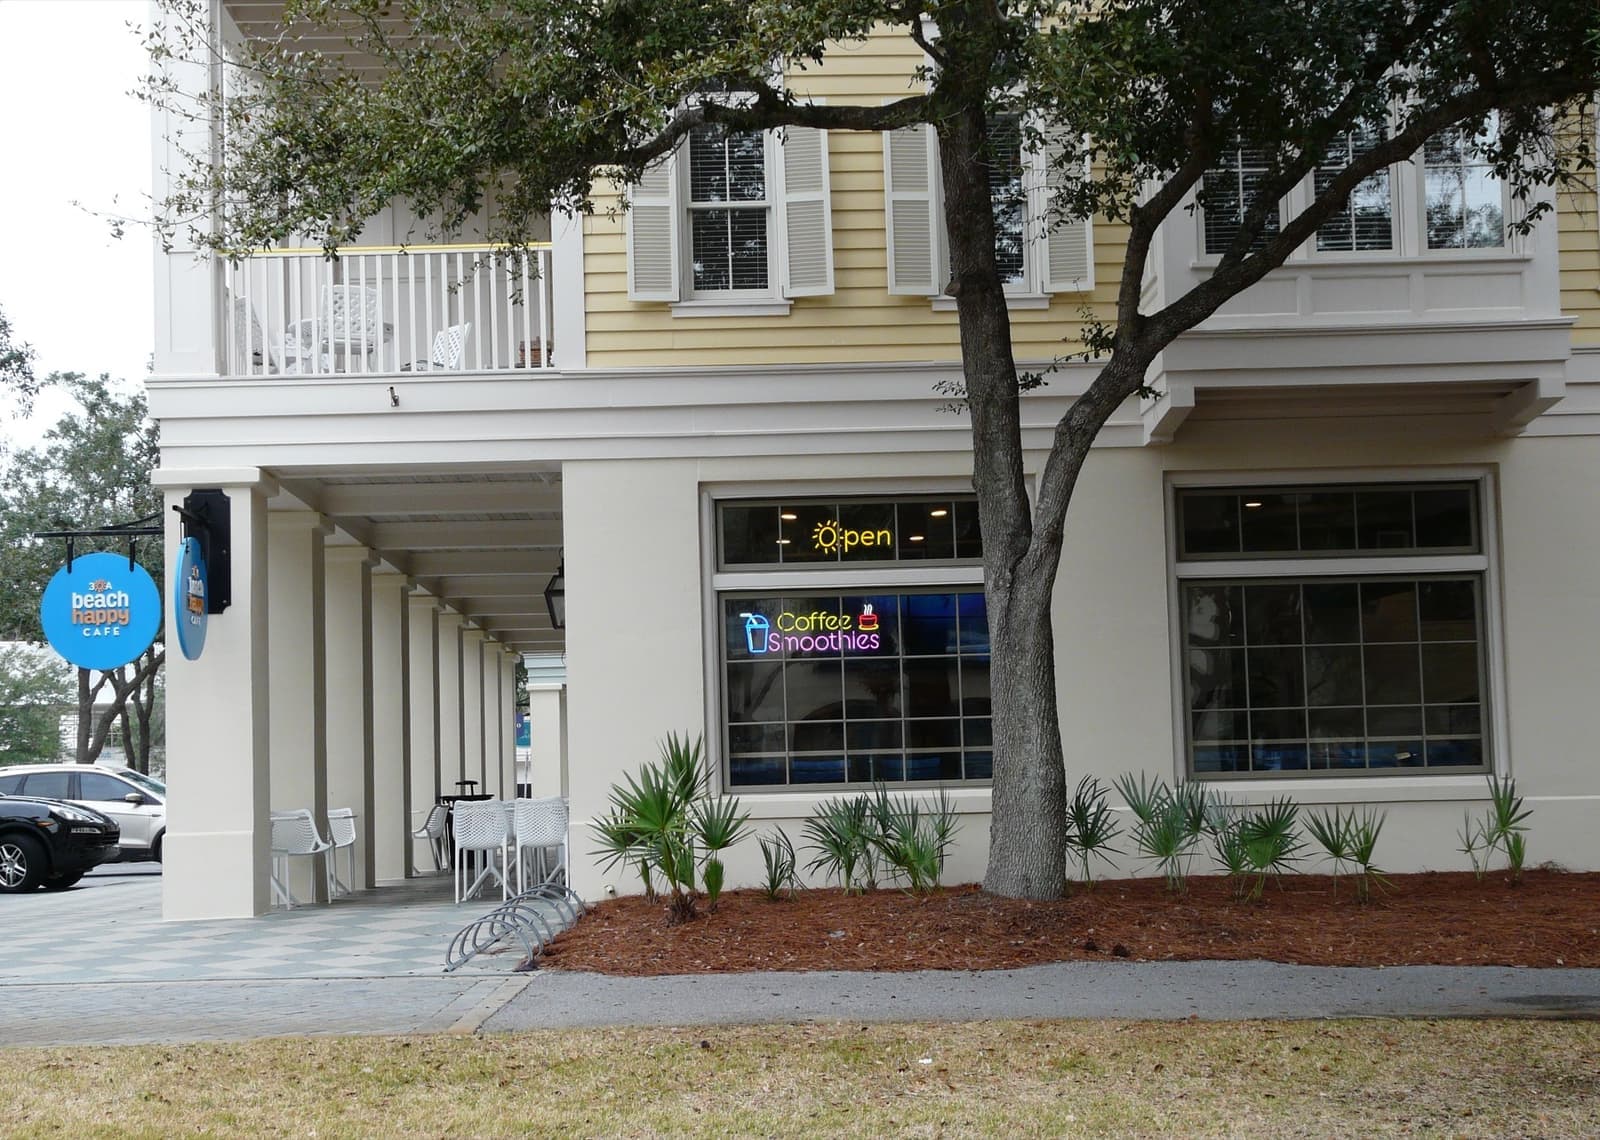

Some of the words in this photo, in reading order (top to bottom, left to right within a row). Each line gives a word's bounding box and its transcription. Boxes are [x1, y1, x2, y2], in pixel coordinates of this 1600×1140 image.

[812, 520, 891, 553] Open
[88, 579, 112, 592] 30A
[72, 591, 129, 609] beach
[72, 609, 129, 626] happy
[777, 611, 852, 632] Coffee
[83, 626, 120, 637] CAFE
[768, 630, 880, 652] Smoothies
